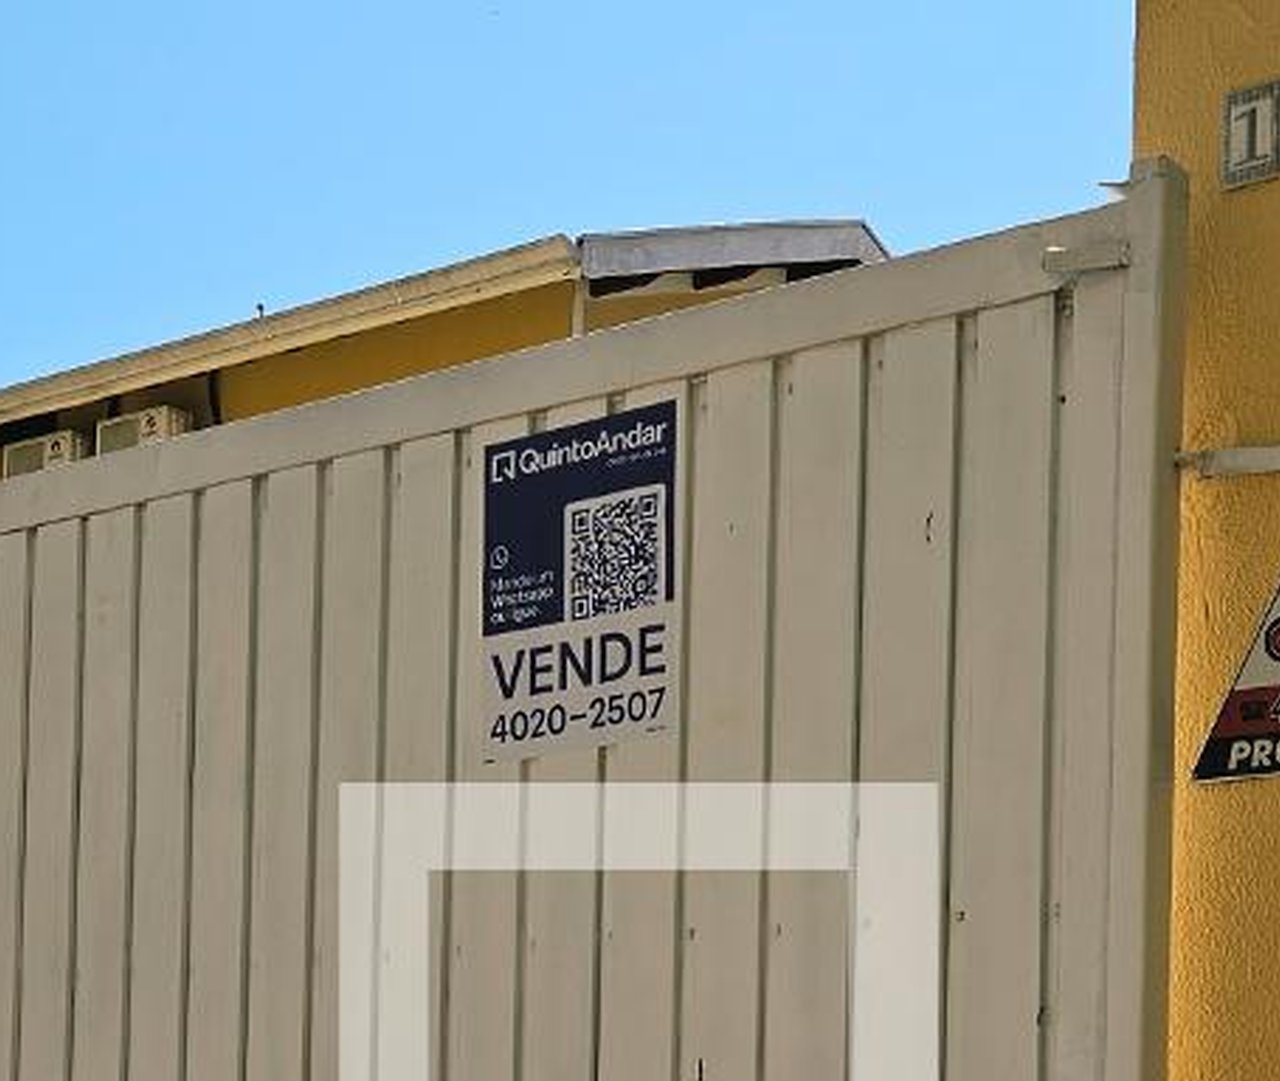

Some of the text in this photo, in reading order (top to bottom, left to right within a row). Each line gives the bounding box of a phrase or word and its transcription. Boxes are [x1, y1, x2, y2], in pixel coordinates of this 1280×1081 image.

[518, 421, 668, 474] QuintoAndar
[491, 624, 666, 700] VENDE
[490, 687, 667, 744] 4020-2507
